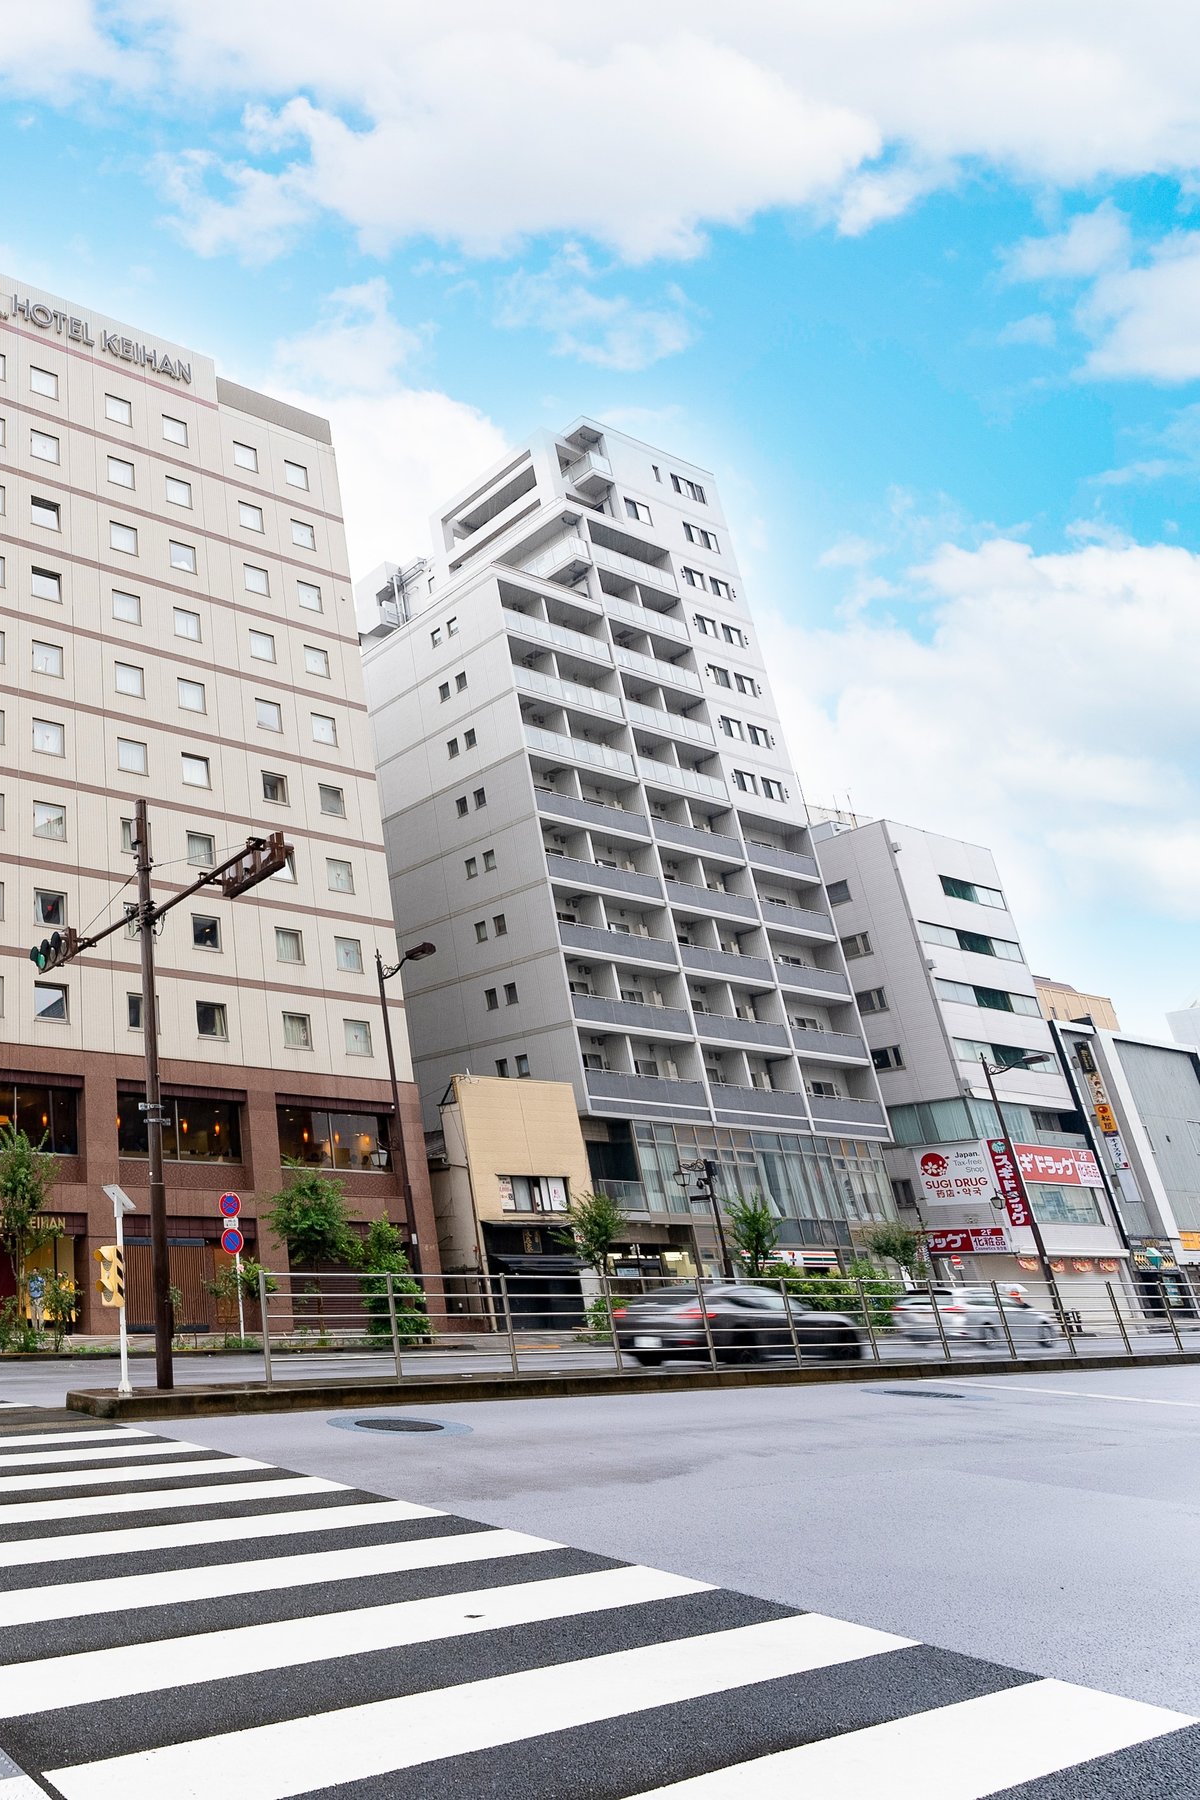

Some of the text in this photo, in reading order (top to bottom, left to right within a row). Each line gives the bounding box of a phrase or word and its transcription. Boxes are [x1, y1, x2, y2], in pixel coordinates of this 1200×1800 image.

[12, 294, 192, 384] HOTEL KEIHAN
[1016, 1152, 1075, 1176] ギドラッグ
[1079, 1151, 1087, 1161] 2F
[925, 1177, 988, 1189] SUGI DRUG
[994, 1155, 1028, 1225] スギドラッグ
